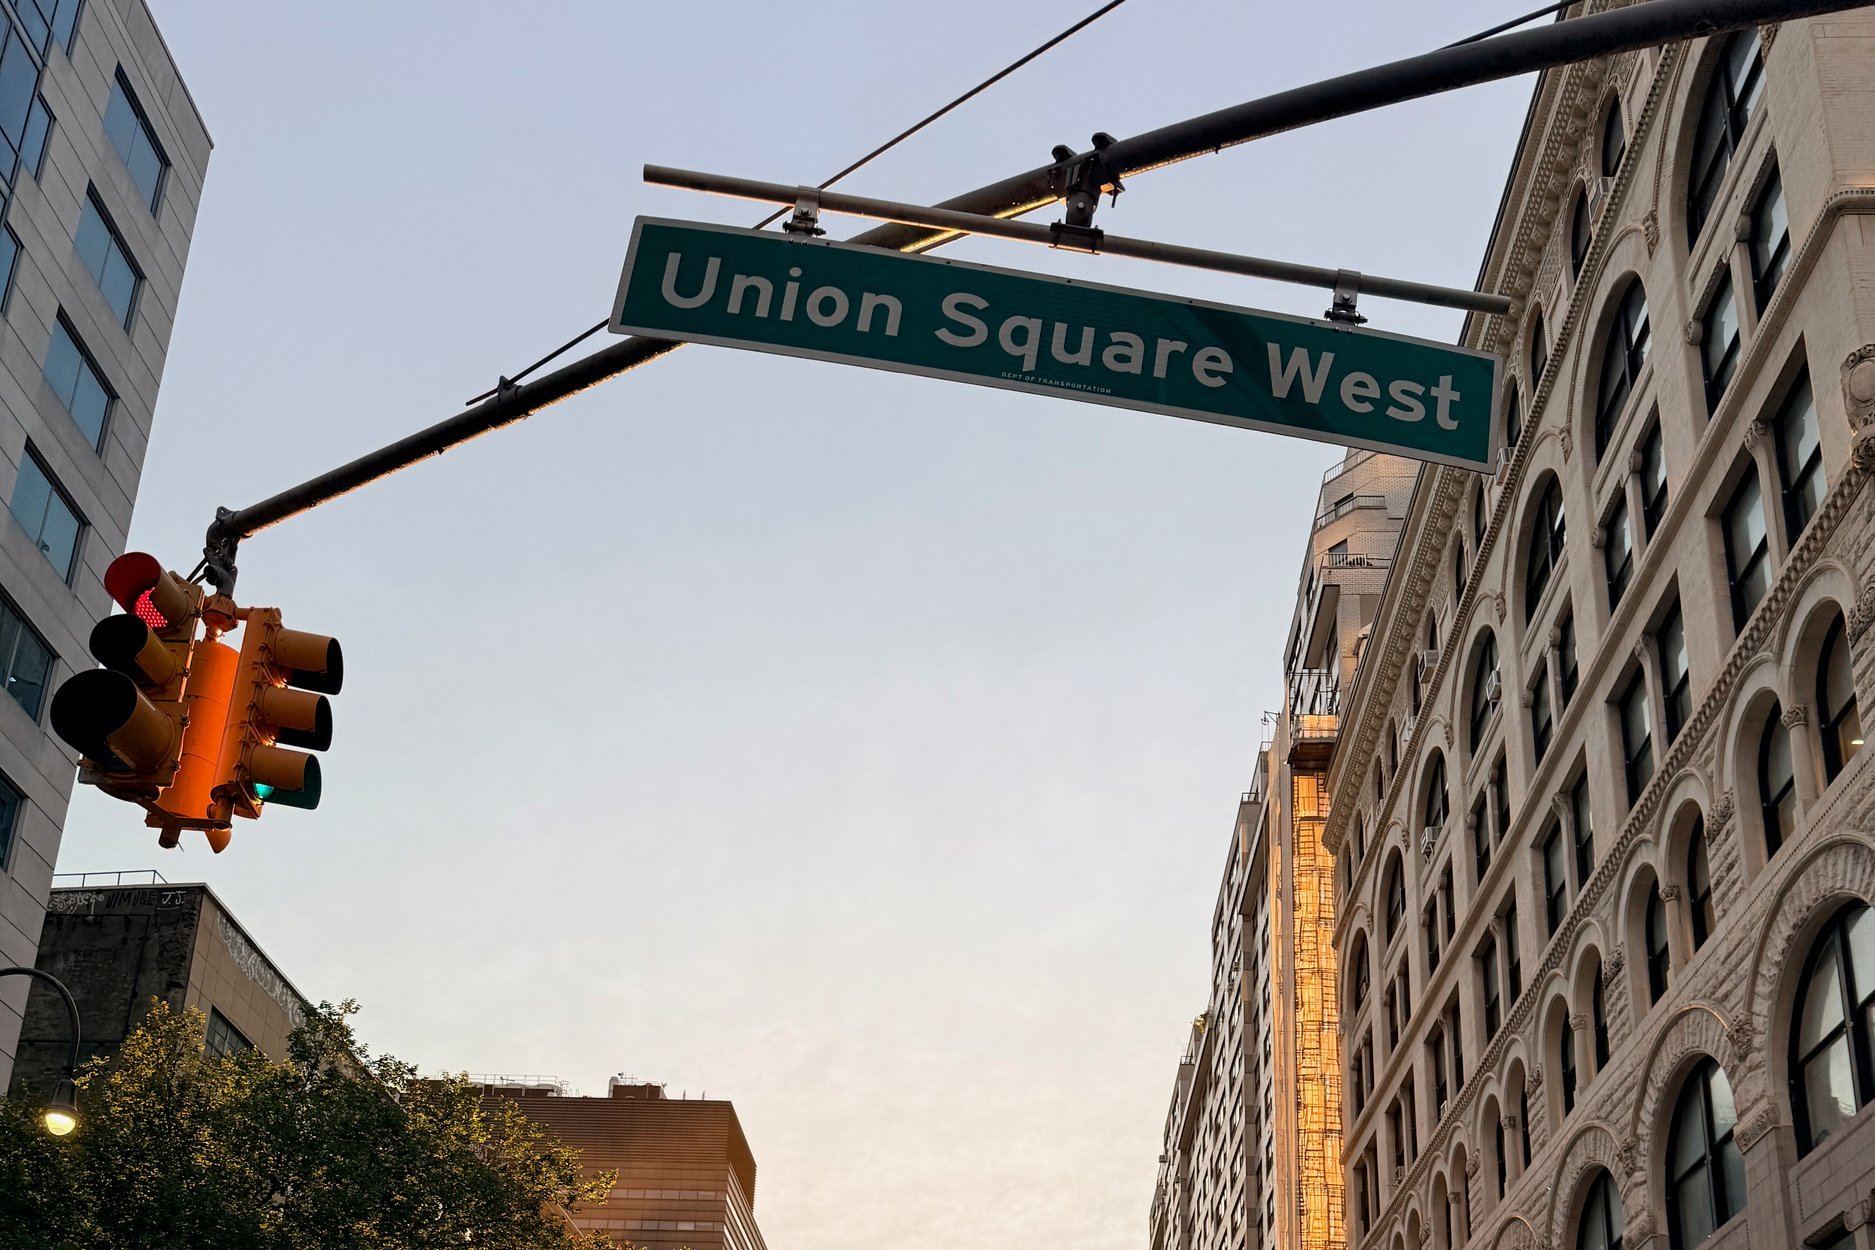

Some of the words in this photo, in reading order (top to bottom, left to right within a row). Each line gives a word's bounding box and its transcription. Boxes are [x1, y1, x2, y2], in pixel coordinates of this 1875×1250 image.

[661, 252, 903, 337] Union
[934, 292, 1234, 388] Square
[1266, 341, 1461, 431] West
[1001, 371, 1023, 381] DEPT
[1037, 377, 1112, 394] TRANSPORTATION
